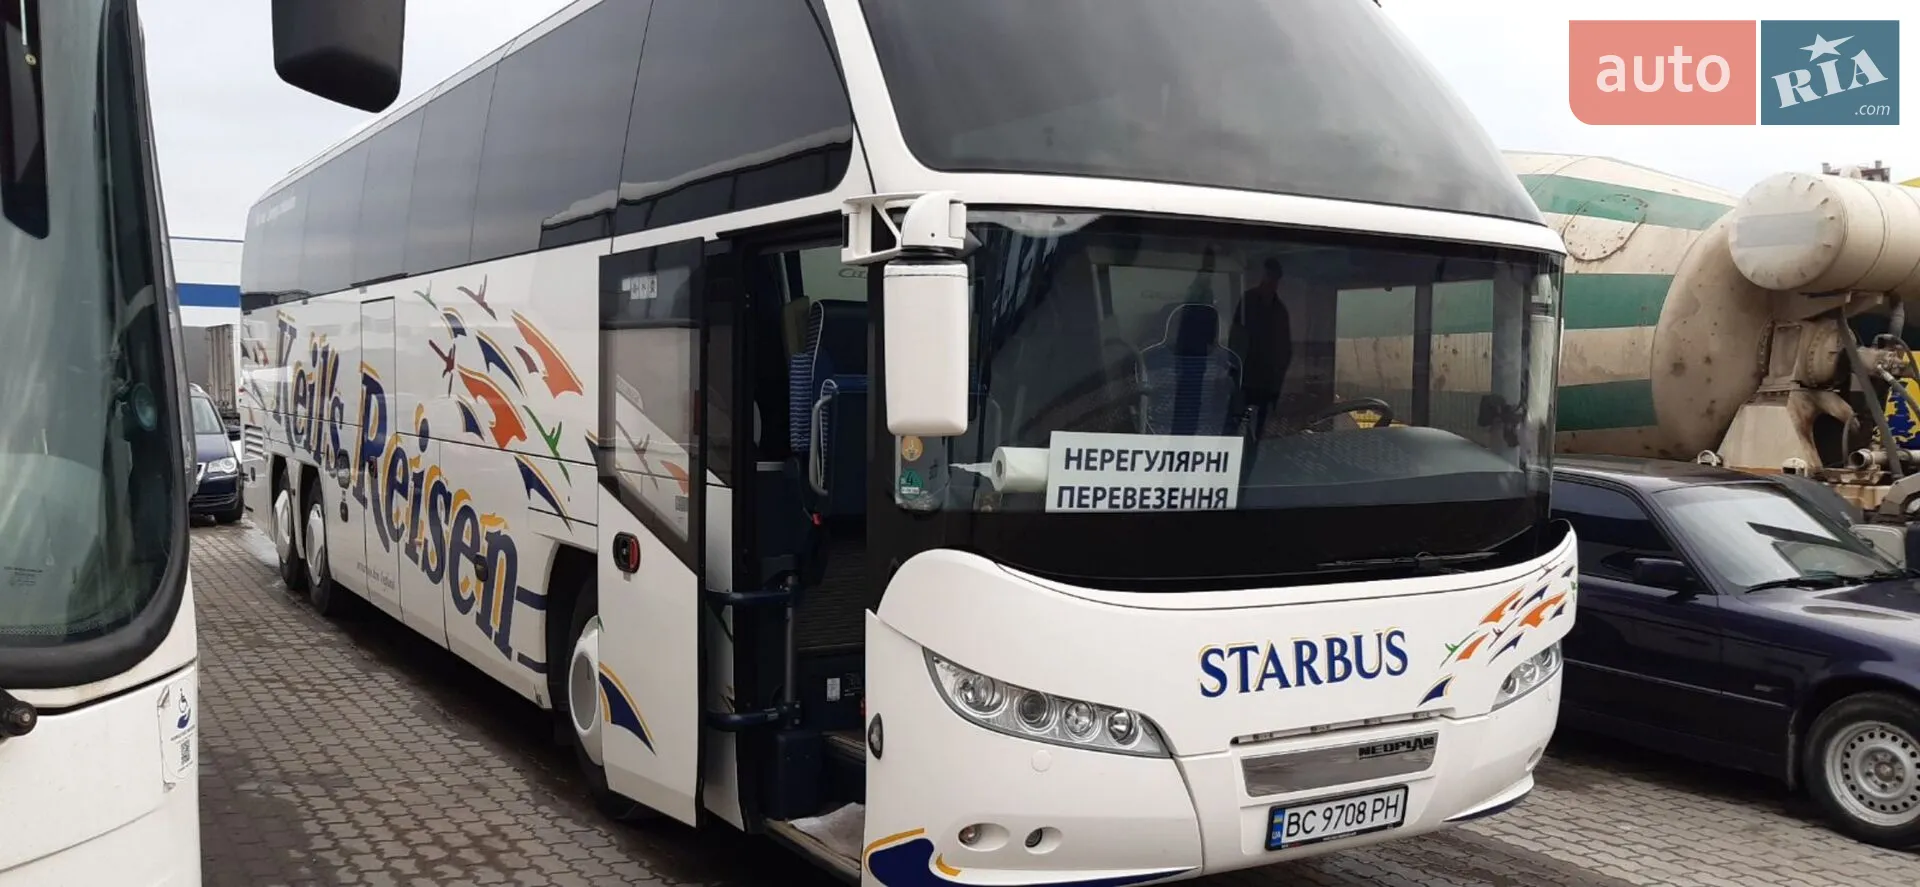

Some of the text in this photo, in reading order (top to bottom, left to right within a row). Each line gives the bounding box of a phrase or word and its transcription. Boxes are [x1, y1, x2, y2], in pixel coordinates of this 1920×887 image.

[1064, 447, 1229, 473] НЕРЕГУЛЯРНІ
[352, 361, 518, 661] Reisen
[1056, 485, 1229, 510] ПЕРЕВЕЗЕННЯ
[1198, 626, 1409, 698] STARBUS
[1358, 736, 1435, 757] NEOPLAN
[1285, 794, 1400, 838] BC 9708 PH
